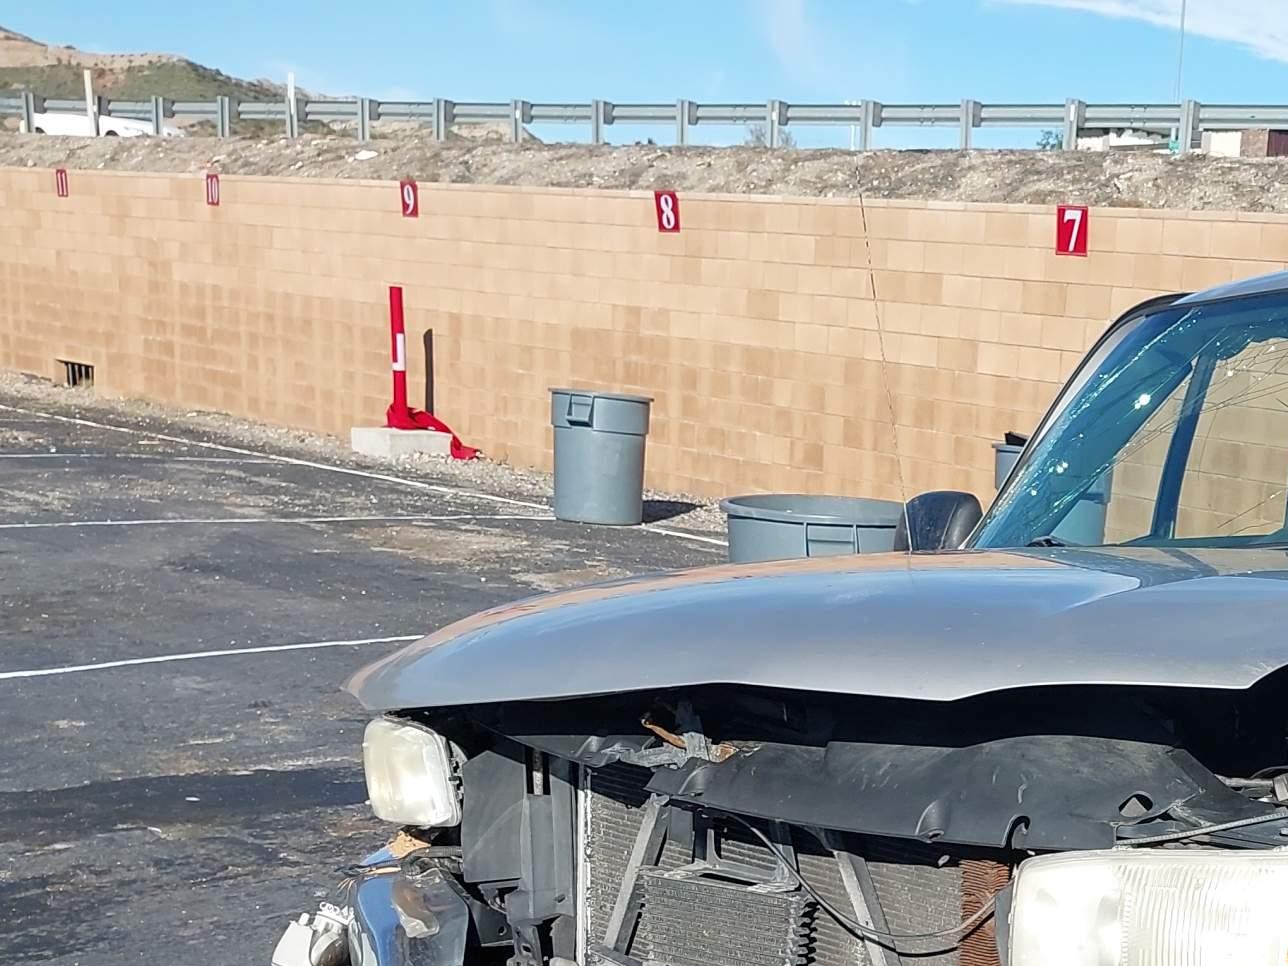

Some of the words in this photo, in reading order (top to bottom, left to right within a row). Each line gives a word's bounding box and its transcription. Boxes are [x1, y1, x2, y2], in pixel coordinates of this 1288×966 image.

[57, 171, 67, 196] 11
[208, 177, 219, 204] 10
[404, 185, 415, 213] 9
[660, 194, 675, 229] 8
[1063, 209, 1082, 252] 7
